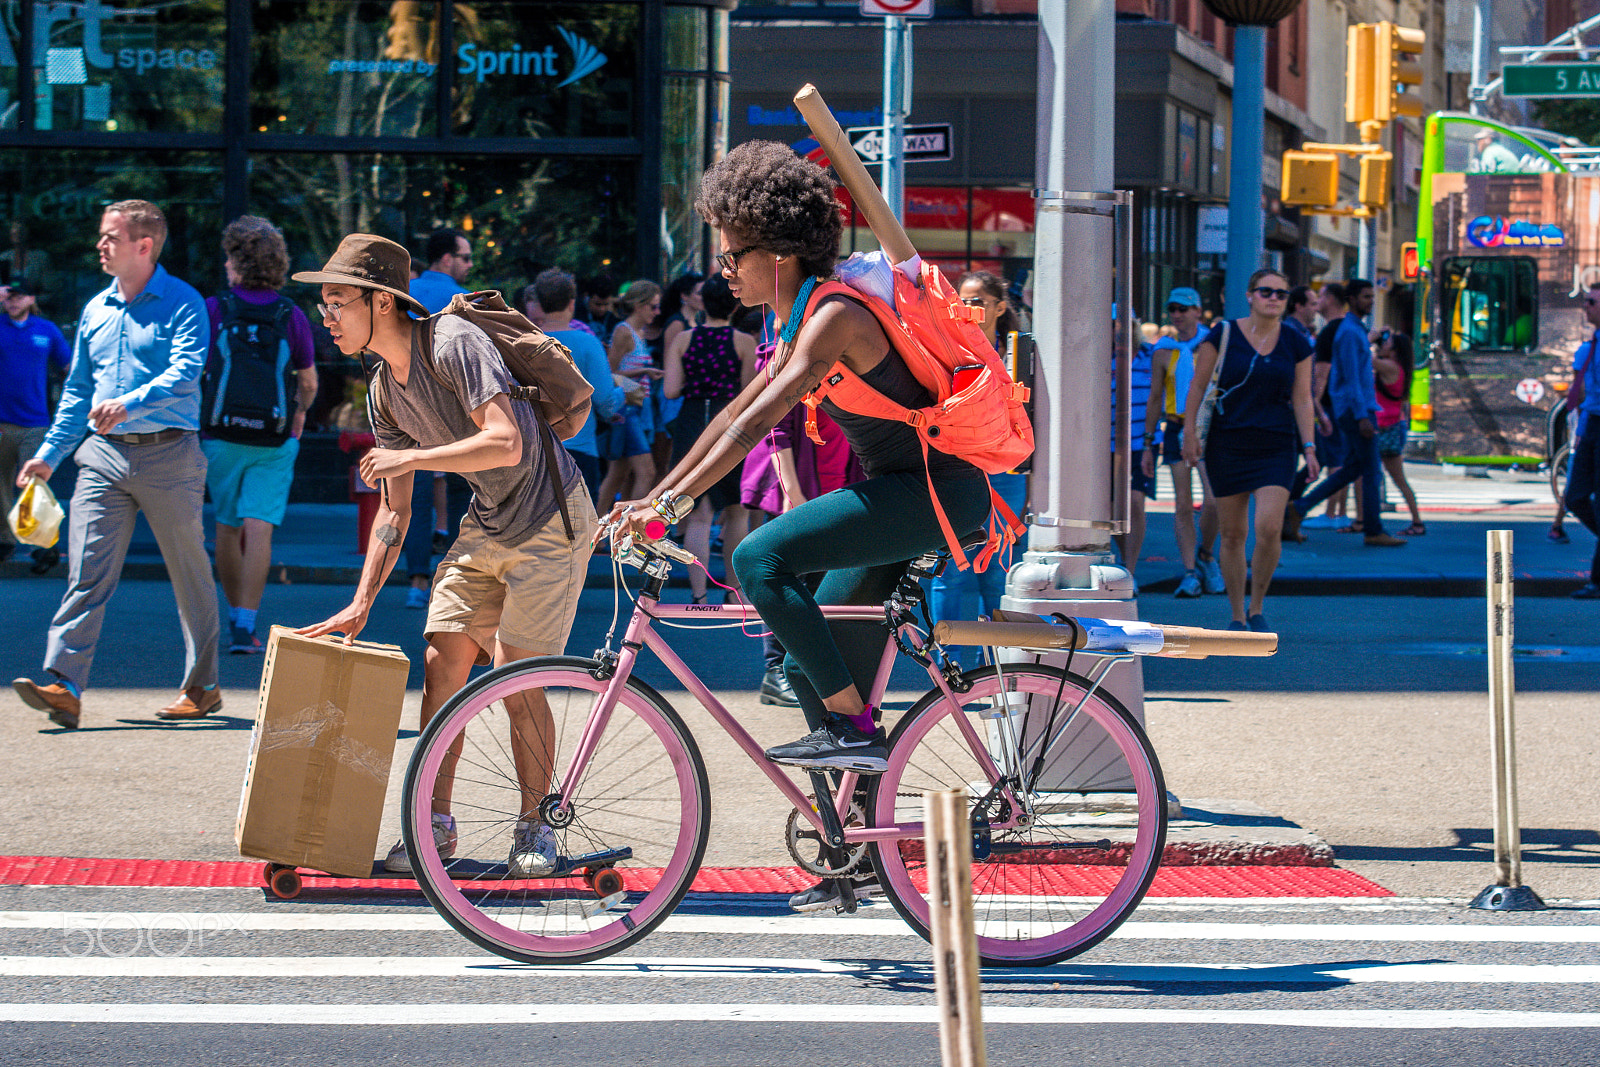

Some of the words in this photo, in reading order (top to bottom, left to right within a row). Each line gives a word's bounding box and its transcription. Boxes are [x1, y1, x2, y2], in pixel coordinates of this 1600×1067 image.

[0, 0, 114, 68] rt
[118, 48, 216, 75] space
[328, 58, 413, 75] presented
[416, 58, 438, 77] by
[457, 43, 558, 83] Sprint
[1556, 69, 1568, 91] 5
[862, 138, 883, 153] ON
[906, 135, 938, 150] WAY
